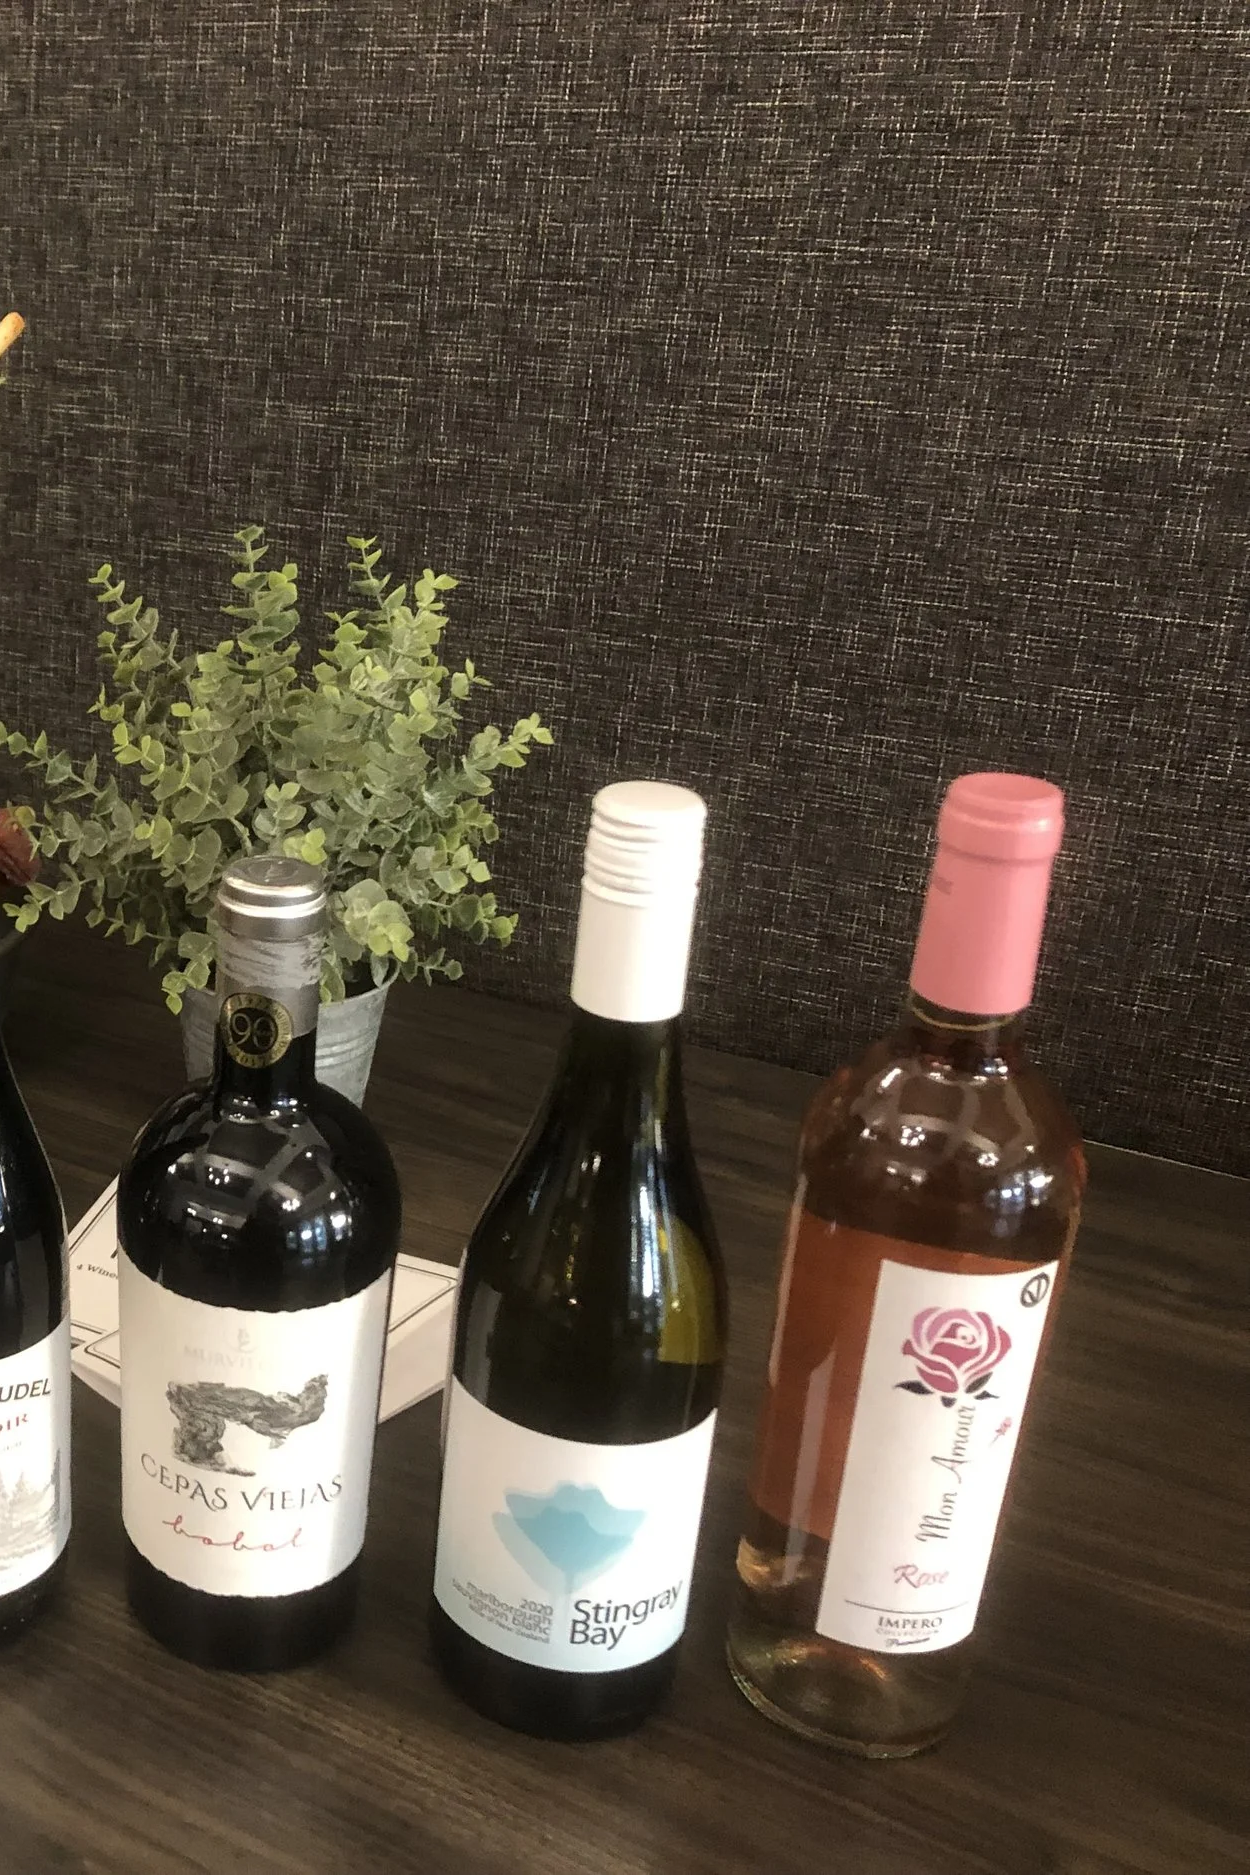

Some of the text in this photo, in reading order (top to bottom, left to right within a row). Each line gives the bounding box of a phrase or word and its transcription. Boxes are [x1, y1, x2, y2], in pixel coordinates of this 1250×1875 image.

[87, 1263, 118, 1279] Wine
[140, 1453, 228, 1511] CEPAS
[915, 1405, 976, 1542] Mon Amour
[519, 1598, 554, 1616] 2020
[573, 1580, 683, 1626] Stingray
[511, 1615, 551, 1636] blanc
[569, 1618, 627, 1650] Bay
[877, 1615, 943, 1629] IMPERO
